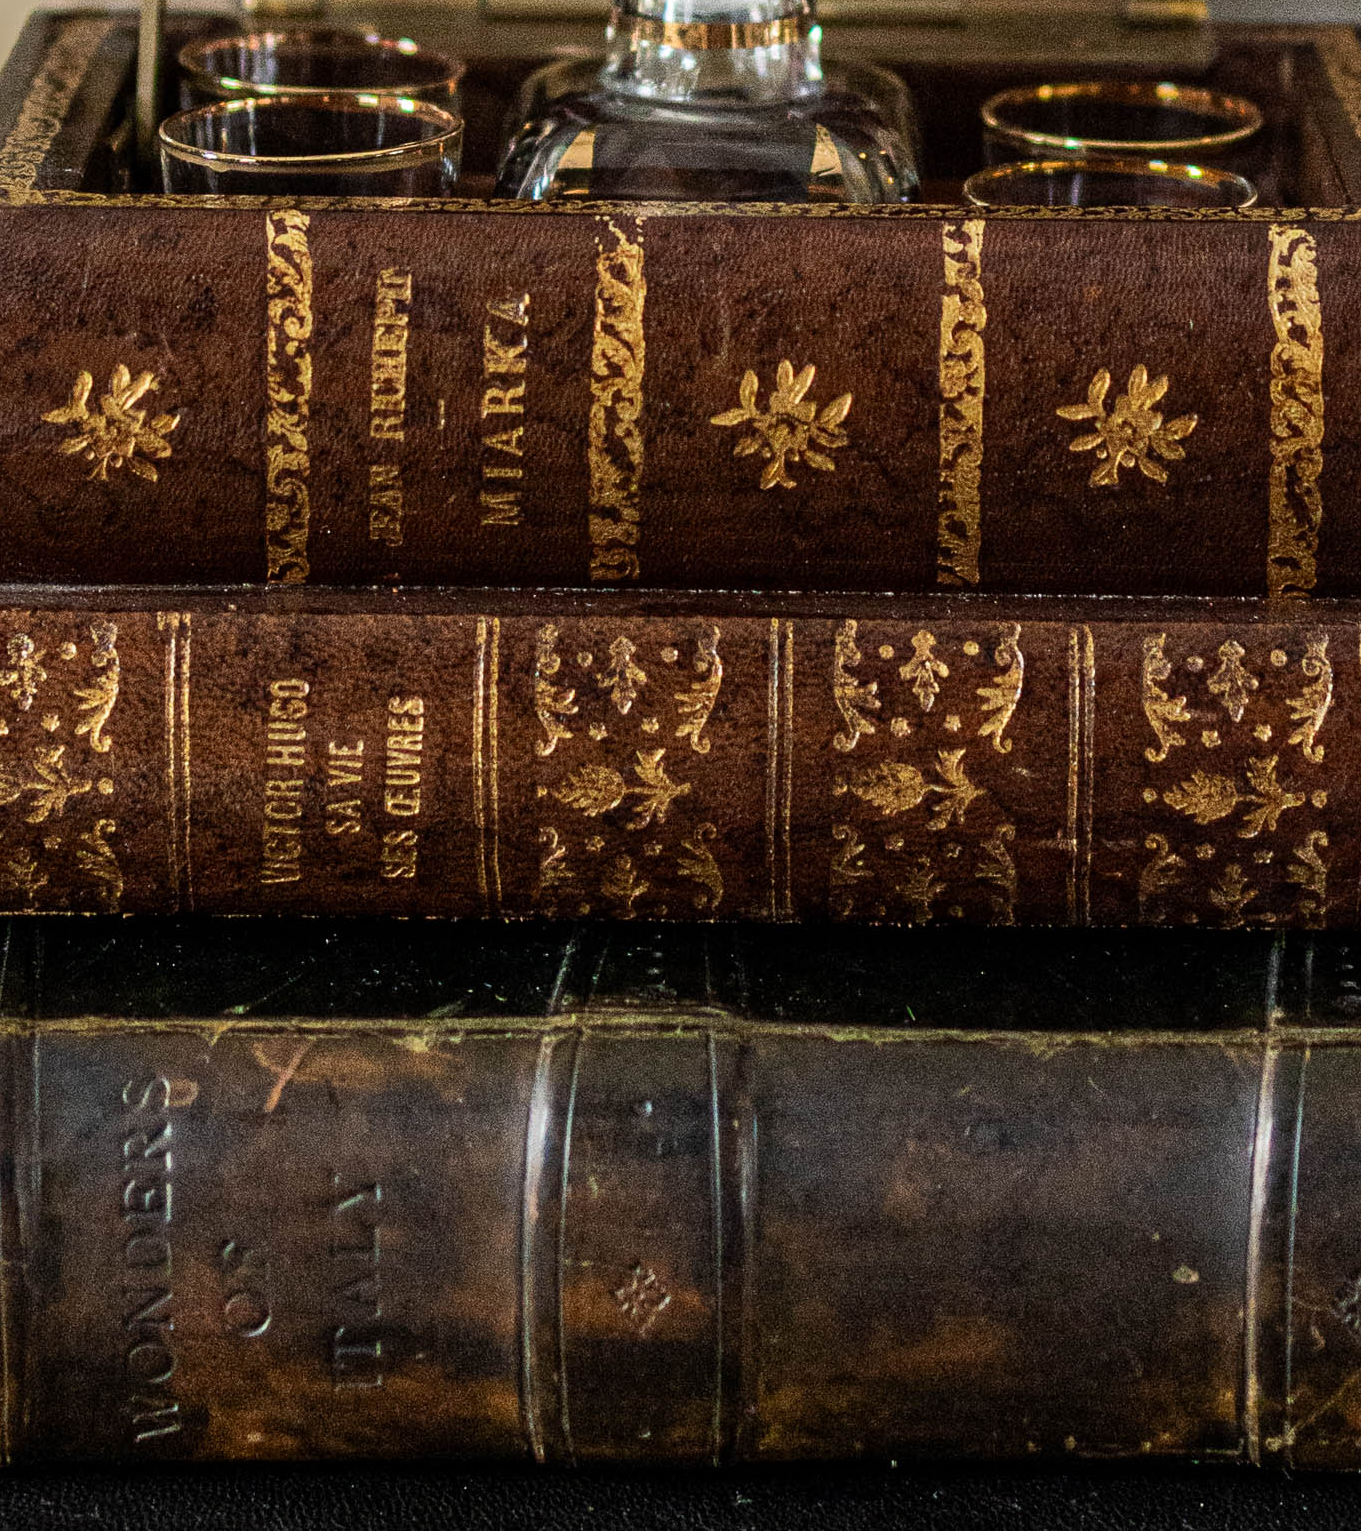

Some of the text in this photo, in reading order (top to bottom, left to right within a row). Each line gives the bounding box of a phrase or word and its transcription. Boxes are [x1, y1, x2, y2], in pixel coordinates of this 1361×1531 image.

[480, 291, 531, 526] MIARKA
[369, 463, 404, 547] JEAN
[261, 678, 310, 884] VICTOR HUGO
[326, 739, 364, 835] SA VIE
[381, 829, 418, 879] SES
[121, 1076, 180, 1443] WONDERS
[223, 1240, 273, 1339] OF
[332, 1172, 383, 1393] ITALY
